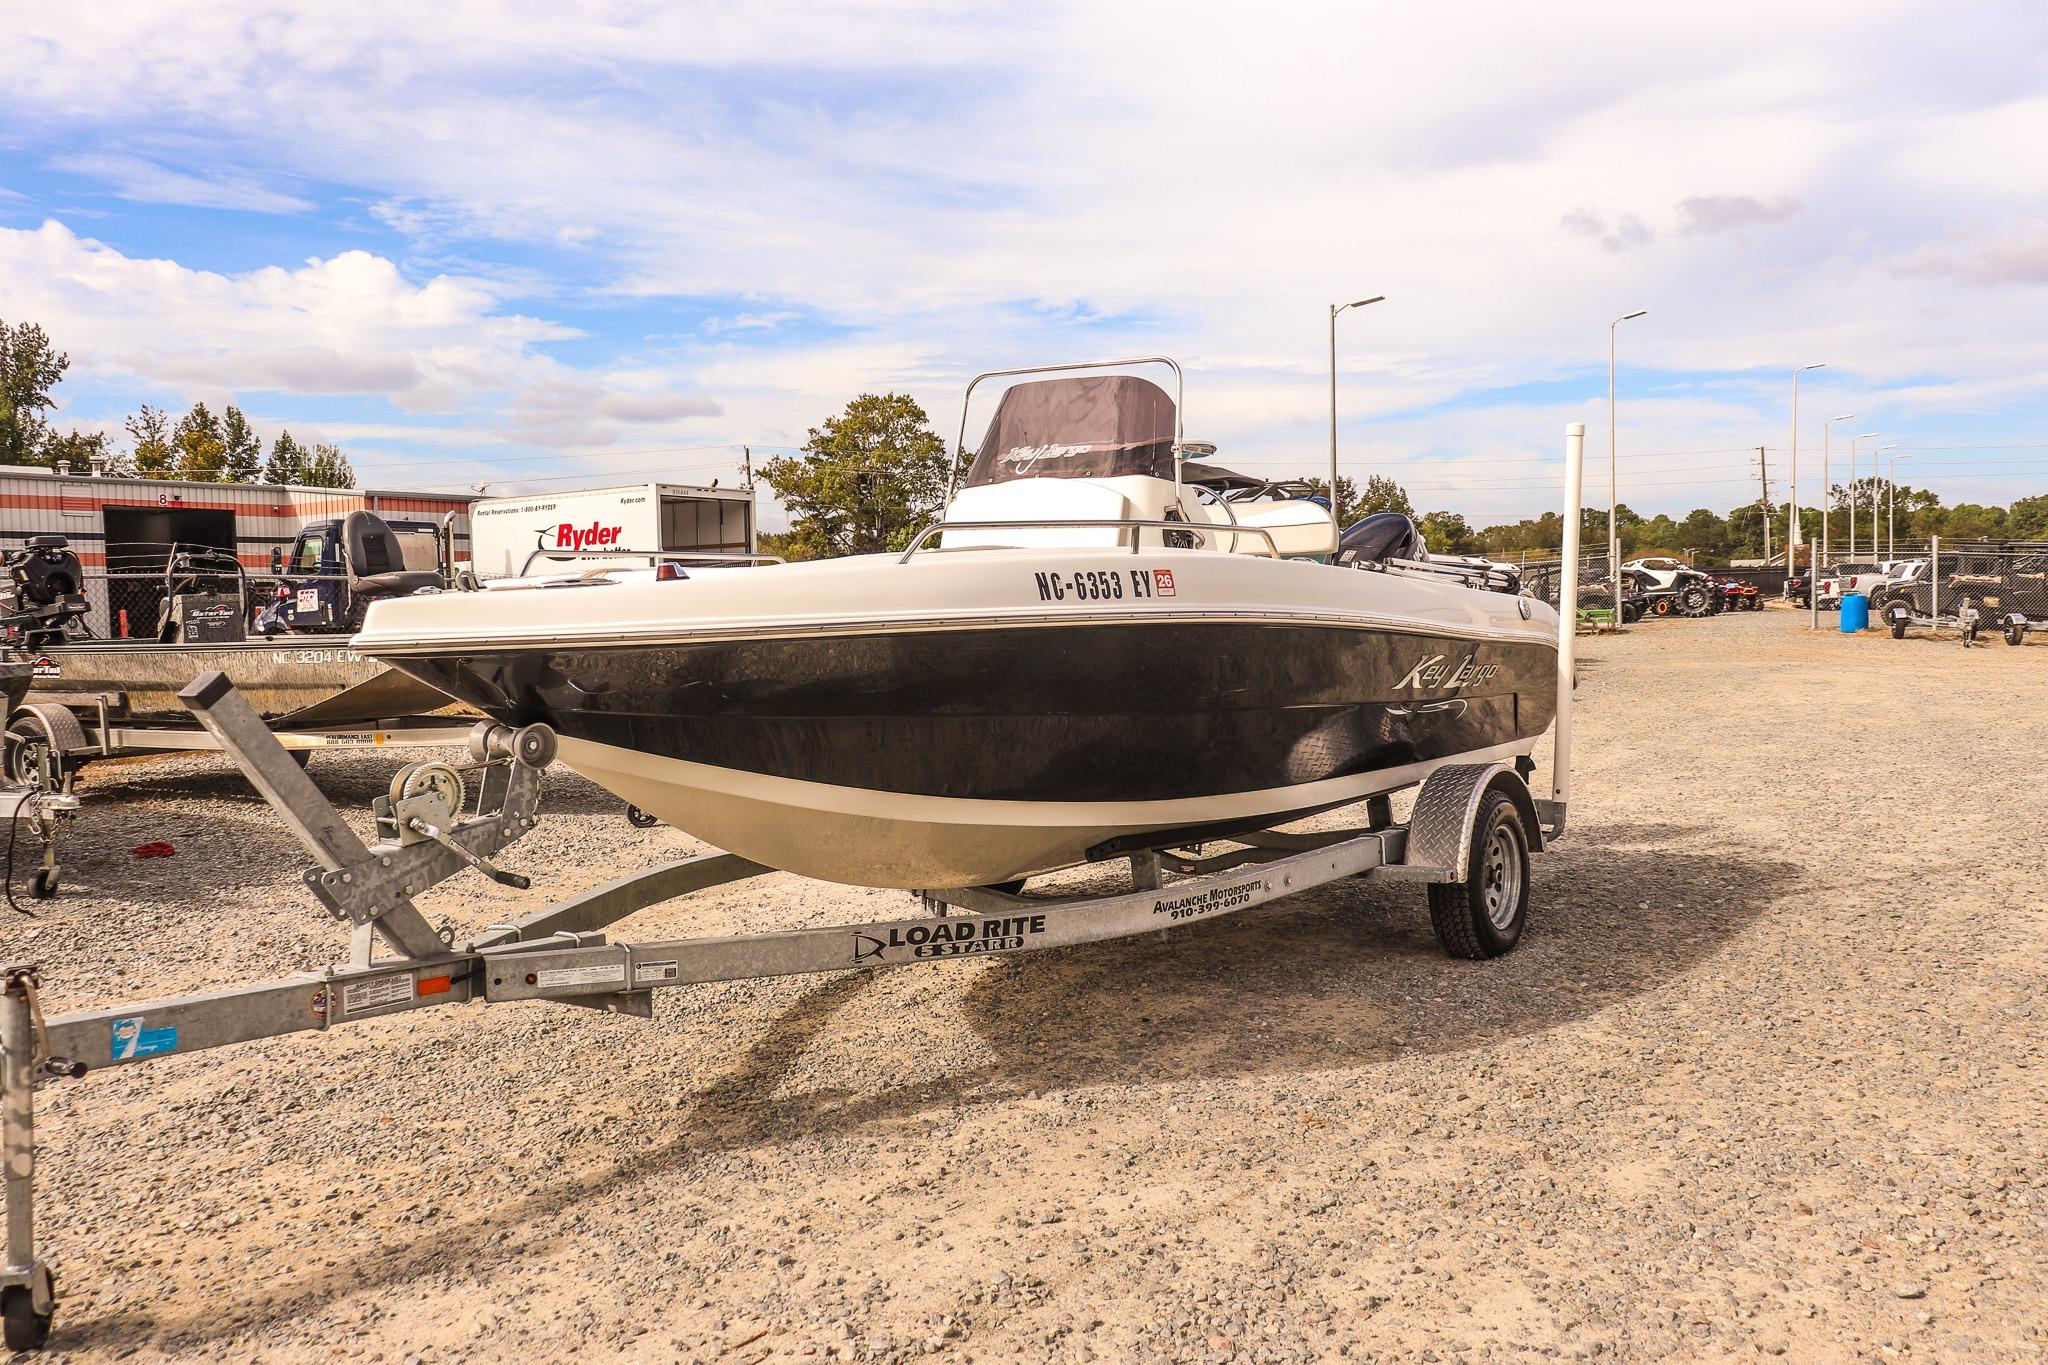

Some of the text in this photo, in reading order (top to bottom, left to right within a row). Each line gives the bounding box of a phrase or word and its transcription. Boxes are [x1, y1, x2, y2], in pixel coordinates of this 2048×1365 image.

[1000, 444, 1048, 474] Key
[159, 494, 167, 505] 8
[521, 503, 557, 513] 1-800-BY-RYDER
[620, 496, 646, 505] Ryder.com
[556, 521, 622, 551] Ryder
[1034, 570, 1152, 601] NC-6353 EY
[1157, 574, 1173, 588] 26
[273, 652, 290, 664] NC
[296, 650, 333, 664] 3204
[1391, 654, 1500, 690] Key Largo
[1152, 879, 1262, 915] AVALANCHE MOTORSPORTS
[1170, 893, 1250, 920] 910-399-6070
[888, 915, 1046, 948] LOAD RITE
[920, 936, 1020, 957] 5 STARR
